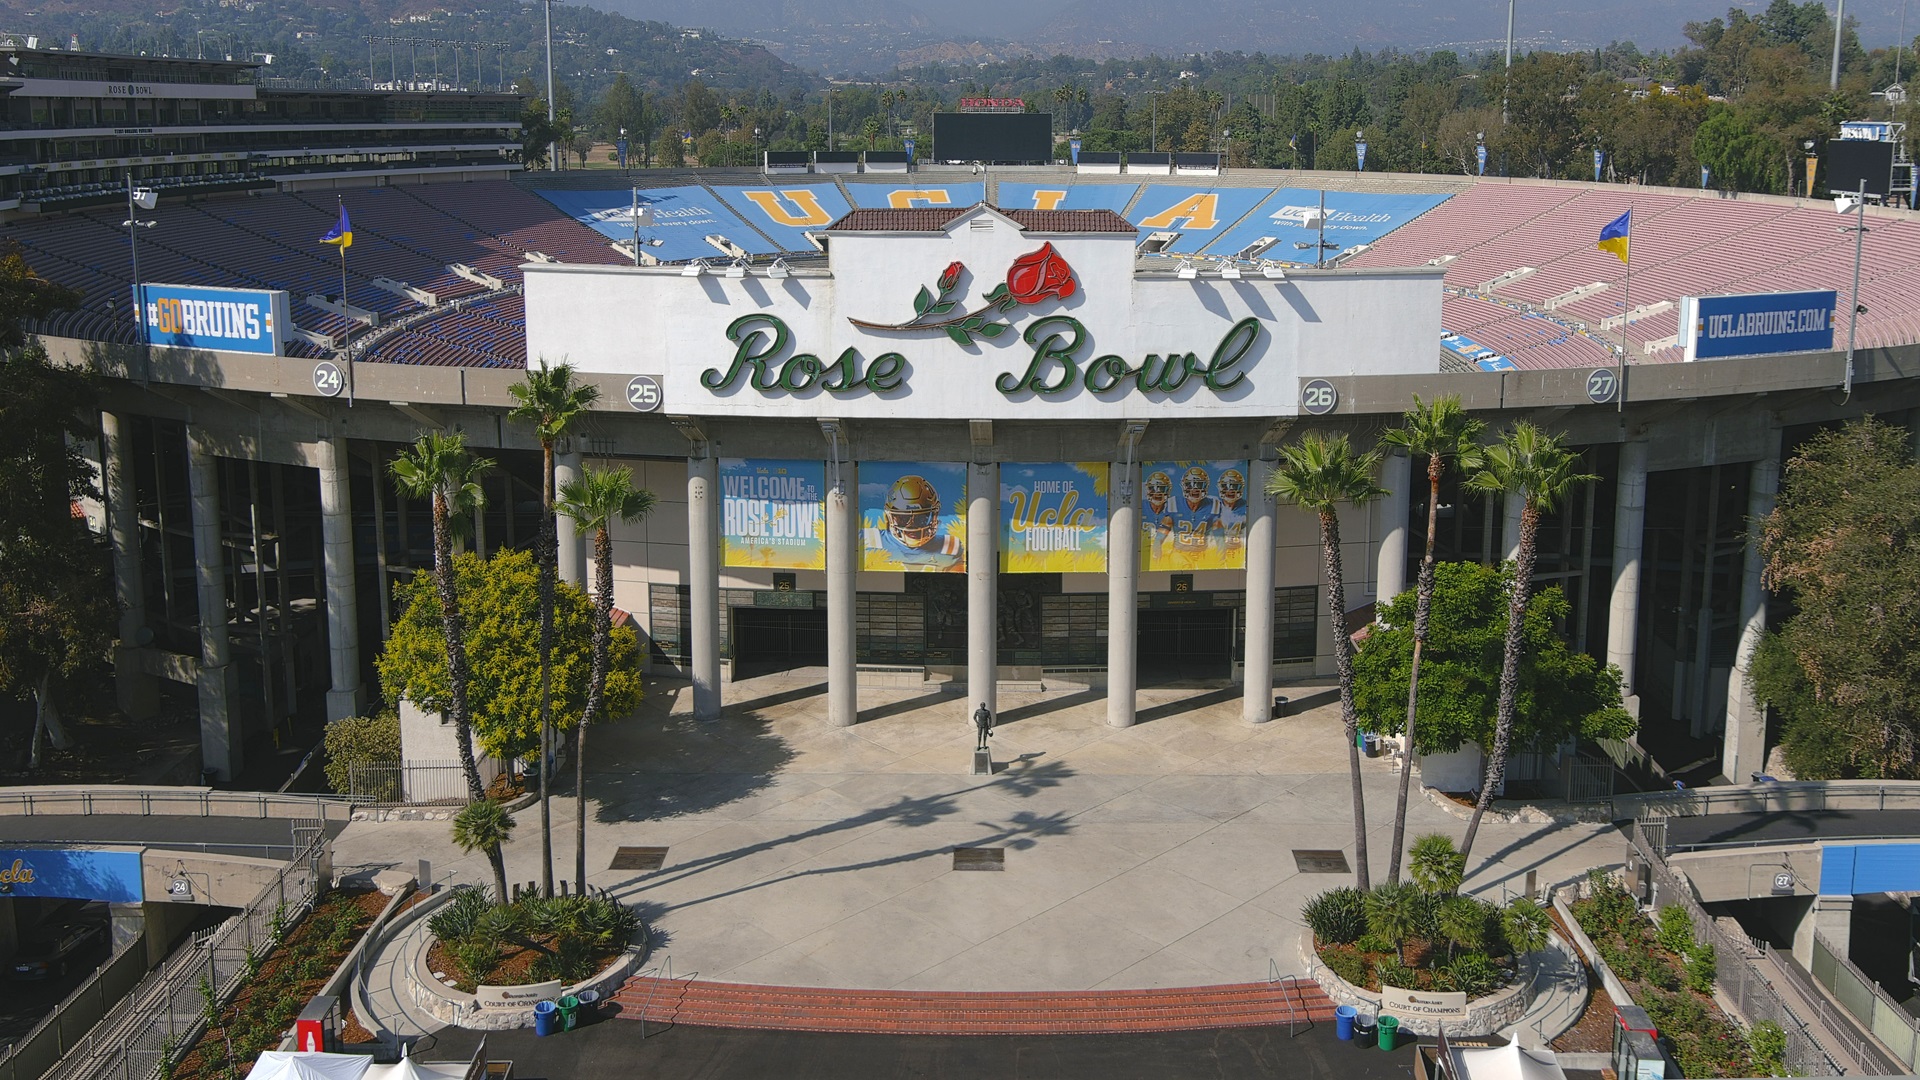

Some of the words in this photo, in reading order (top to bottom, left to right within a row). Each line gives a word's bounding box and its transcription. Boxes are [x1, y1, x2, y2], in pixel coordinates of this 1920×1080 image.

[108, 85, 126, 94] ROSE
[136, 86, 152, 94] BOWL
[961, 98, 1025, 107] HONDA
[1328, 212, 1391, 222] Health
[147, 298, 260, 340] #GOBRUINS
[1709, 308, 1826, 339] UCLABRUINS.COM
[700, 313, 906, 392] Rose
[996, 315, 1262, 394] Bowl
[317, 370, 339, 388] 24
[1590, 376, 1613, 395] 27
[630, 384, 657, 403] 25
[1305, 388, 1332, 406] 26
[722, 475, 805, 500] WELCOME
[1034, 481, 1060, 493] HOME
[1063, 481, 1074, 493] OF
[724, 499, 769, 536] ROSE
[1009, 490, 1096, 533] Ucla
[741, 537, 775, 545] AMERICA'S
[1025, 527, 1081, 551] FOOTBALL
[1178, 520, 1207, 545] 24
[779, 581, 790, 590] 25
[1176, 583, 1188, 592] 26
[0, 858, 35, 883] cla
[175, 883, 186, 891] 24
[1778, 877, 1788, 885] 27
[1389, 1001, 1411, 1011] COURT
[1423, 1006, 1461, 1014] CHAMPIONS
